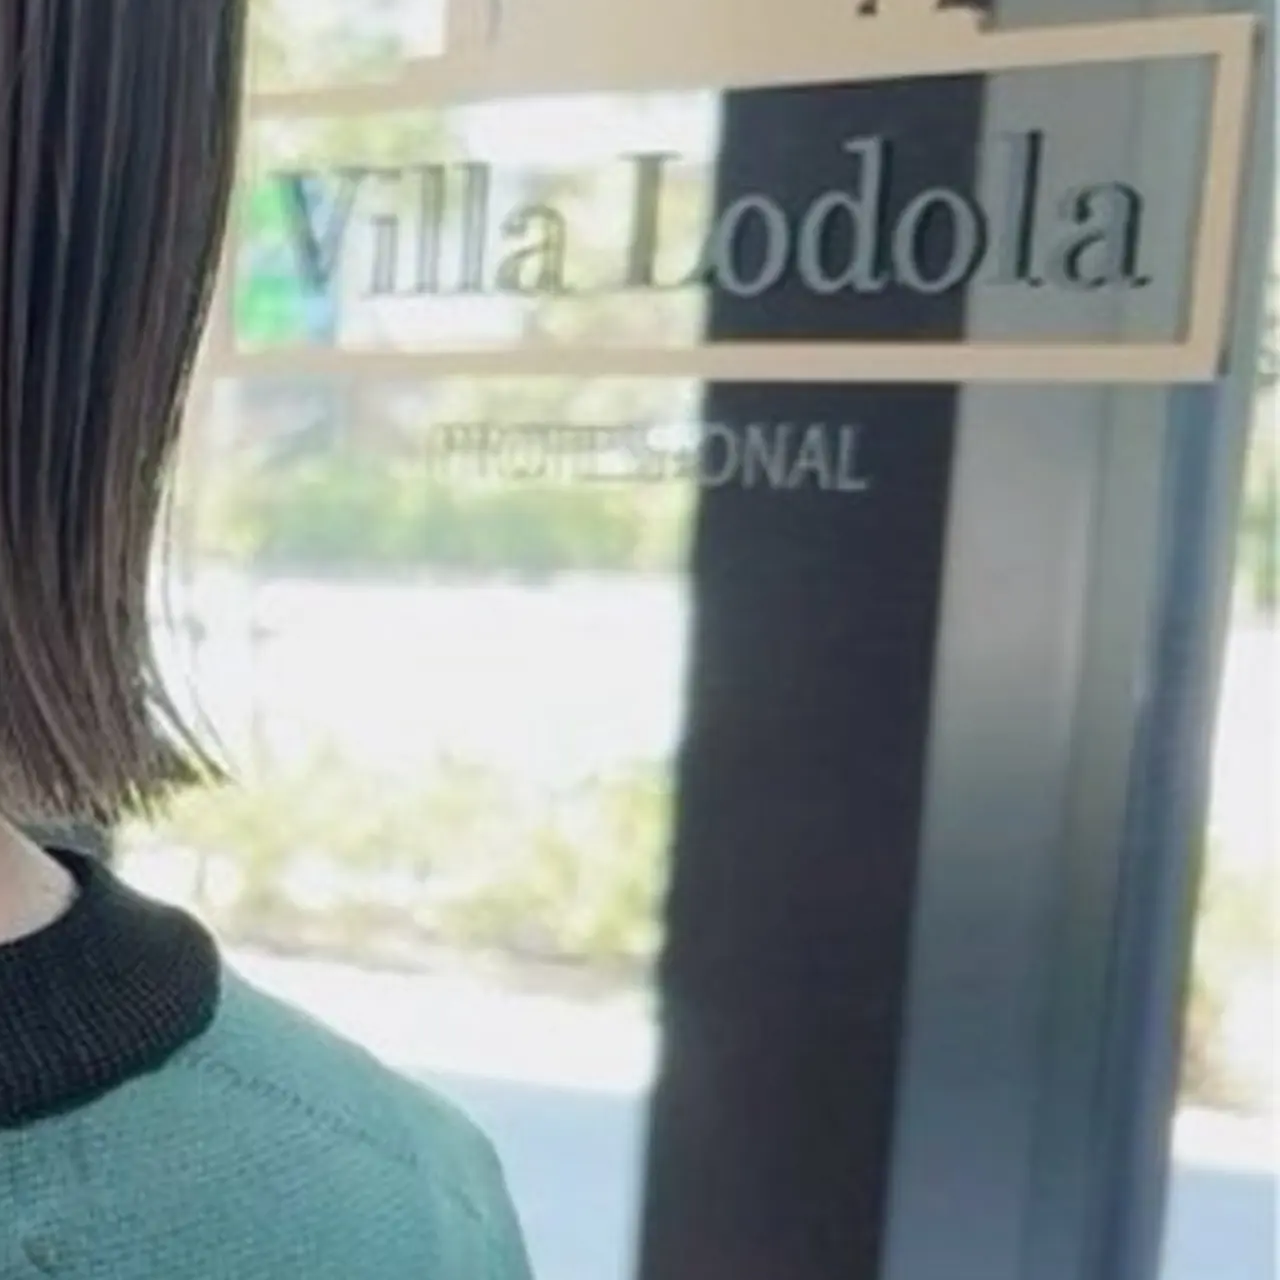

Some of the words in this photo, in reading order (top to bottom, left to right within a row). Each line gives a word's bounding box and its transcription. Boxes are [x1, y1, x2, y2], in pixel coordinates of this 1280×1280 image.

[266, 158, 578, 300] Villa
[616, 126, 1154, 298] Lodola
[426, 422, 870, 492] PROFEIONAL
